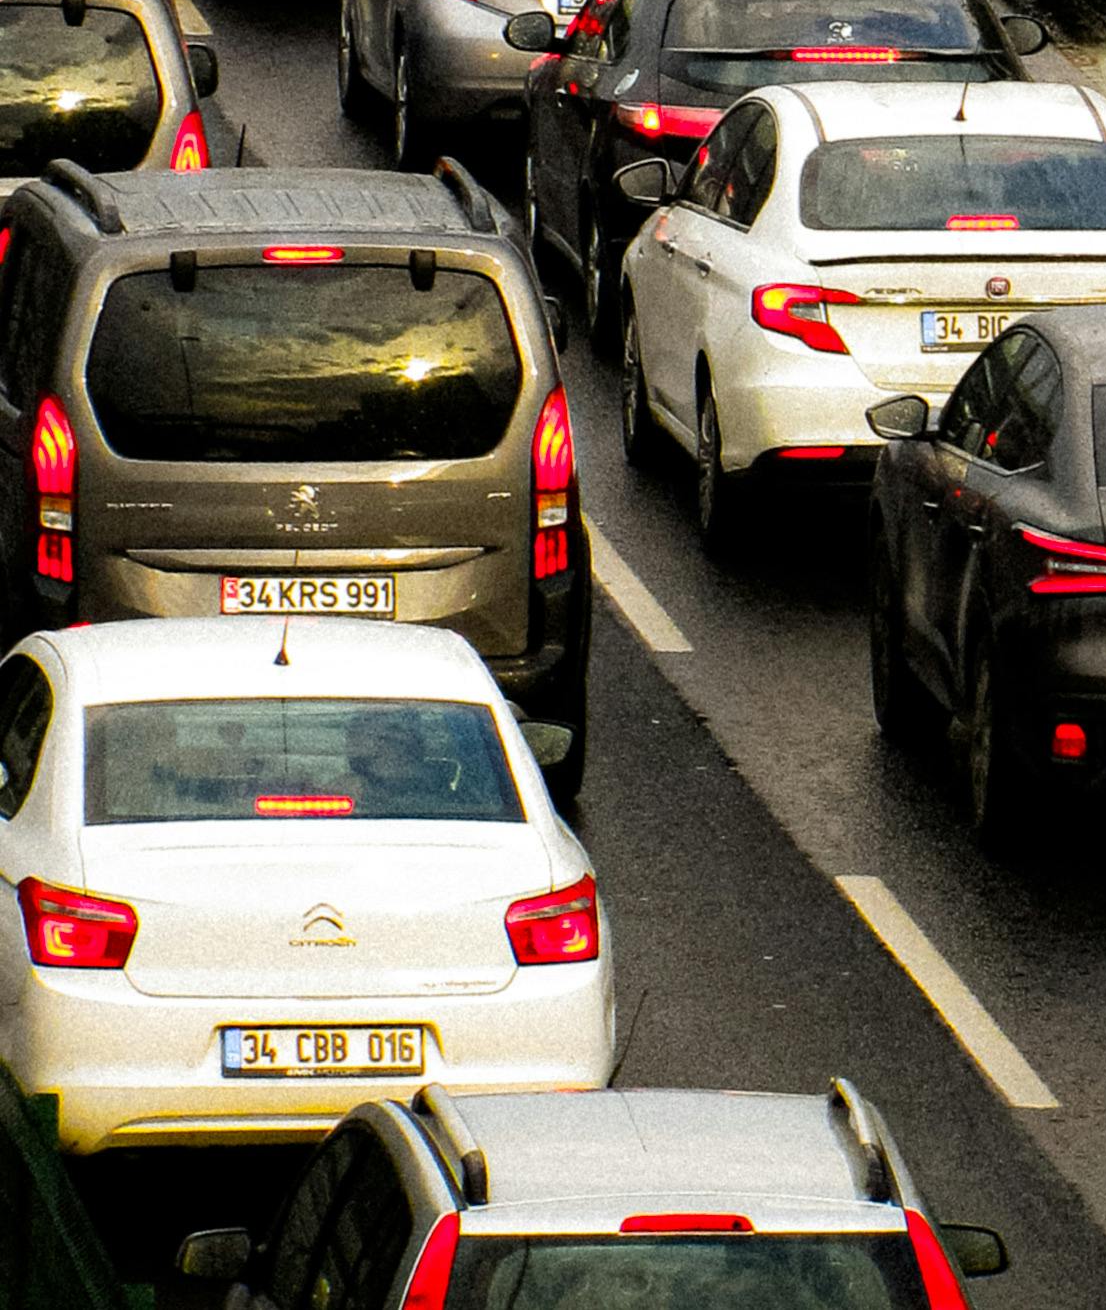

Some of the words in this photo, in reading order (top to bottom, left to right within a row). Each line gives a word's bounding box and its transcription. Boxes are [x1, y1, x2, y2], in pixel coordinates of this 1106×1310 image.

[936, 316, 963, 340] 34
[239, 581, 272, 608] 34
[279, 581, 338, 608] KRS
[346, 581, 391, 608] 991
[243, 1033, 277, 1064] 34
[296, 1032, 348, 1063] CBB
[368, 1032, 415, 1063] 016
